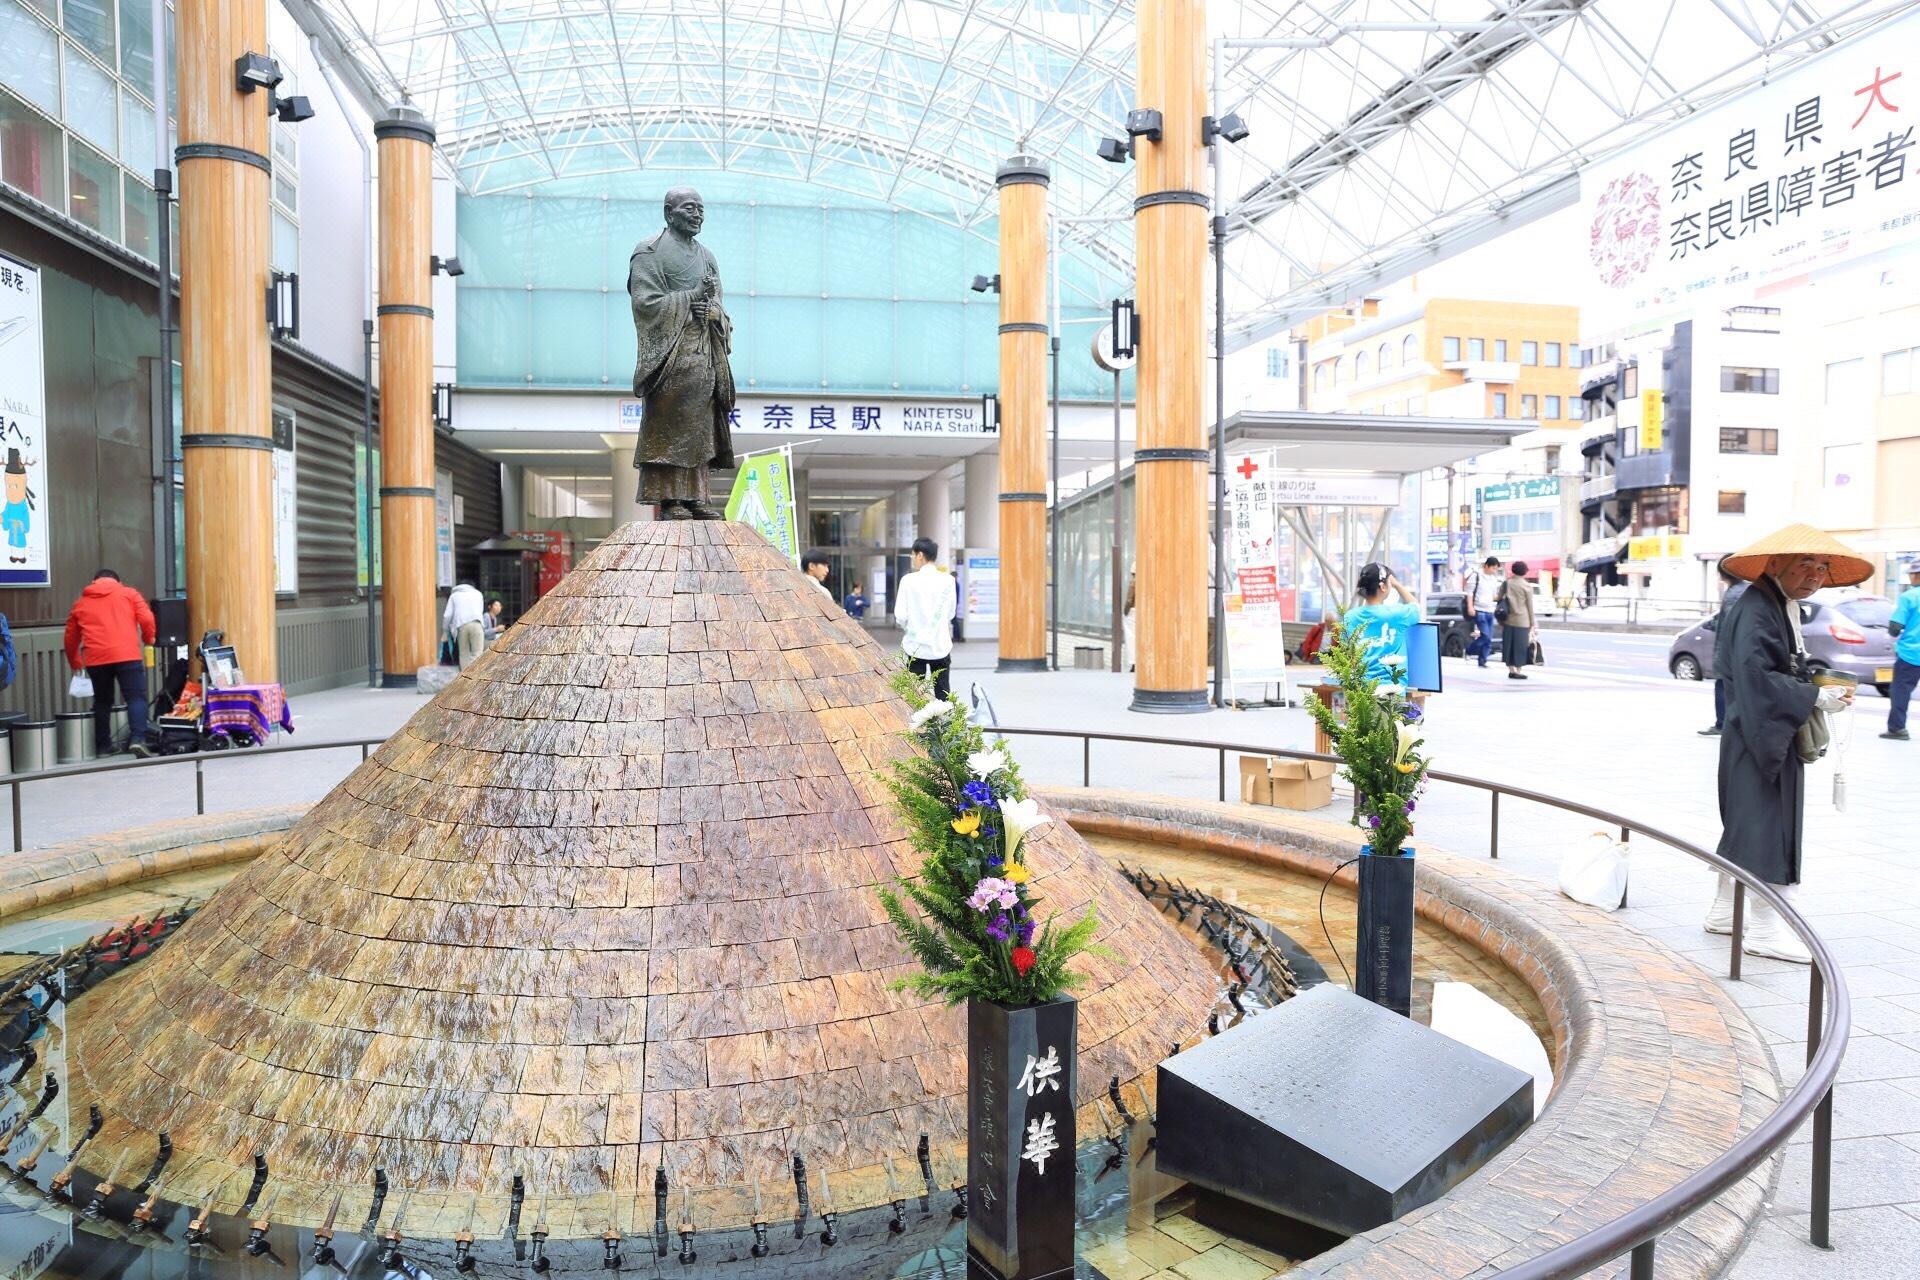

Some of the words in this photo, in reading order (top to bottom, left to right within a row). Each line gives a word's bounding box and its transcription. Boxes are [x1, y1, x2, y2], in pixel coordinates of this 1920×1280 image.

[1670, 126, 1919, 261] 奈良県障害者
[4, 397, 31, 416] NARA
[904, 407, 973, 419] KINTETSU
[904, 421, 943, 432] NARA
[949, 421, 985, 433] Statio
[1253, 482, 1268, 511] 献血に
[1236, 483, 1250, 563] ご協力お願いします
[1016, 1045, 1062, 1176] 供華
